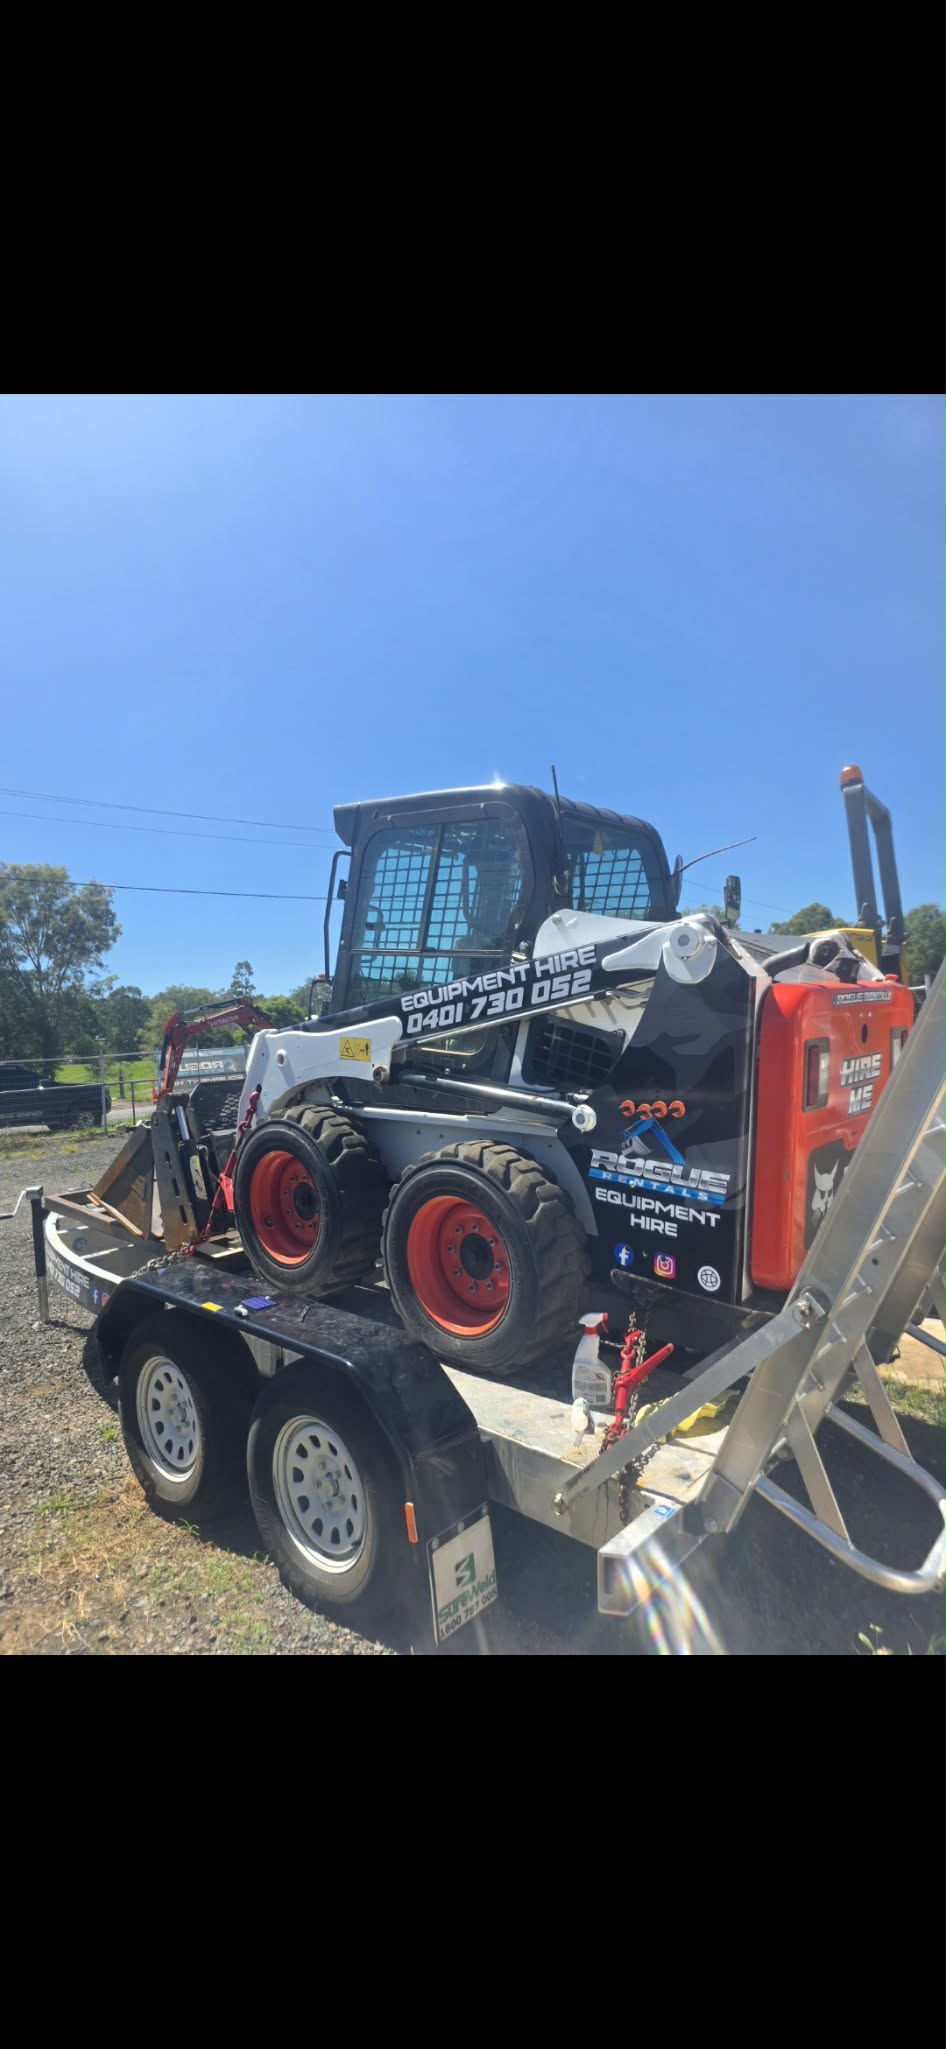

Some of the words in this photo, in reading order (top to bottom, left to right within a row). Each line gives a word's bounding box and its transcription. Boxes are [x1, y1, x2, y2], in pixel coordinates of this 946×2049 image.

[401, 963, 531, 1012] EQUIPMENT
[535, 945, 597, 978] HIRE
[406, 1003, 464, 1034] 0401
[470, 986, 524, 1019] 730
[530, 968, 592, 1005] 052
[840, 1053, 882, 1087] HIRE
[848, 1083, 873, 1115] ME
[590, 1149, 731, 1194] ROGUE
[602, 1171, 709, 1201] RENTALS
[595, 1187, 720, 1227] EQUIPMENT
[630, 1213, 678, 1237] HIRE
[71, 1268, 90, 1290] HIRE
